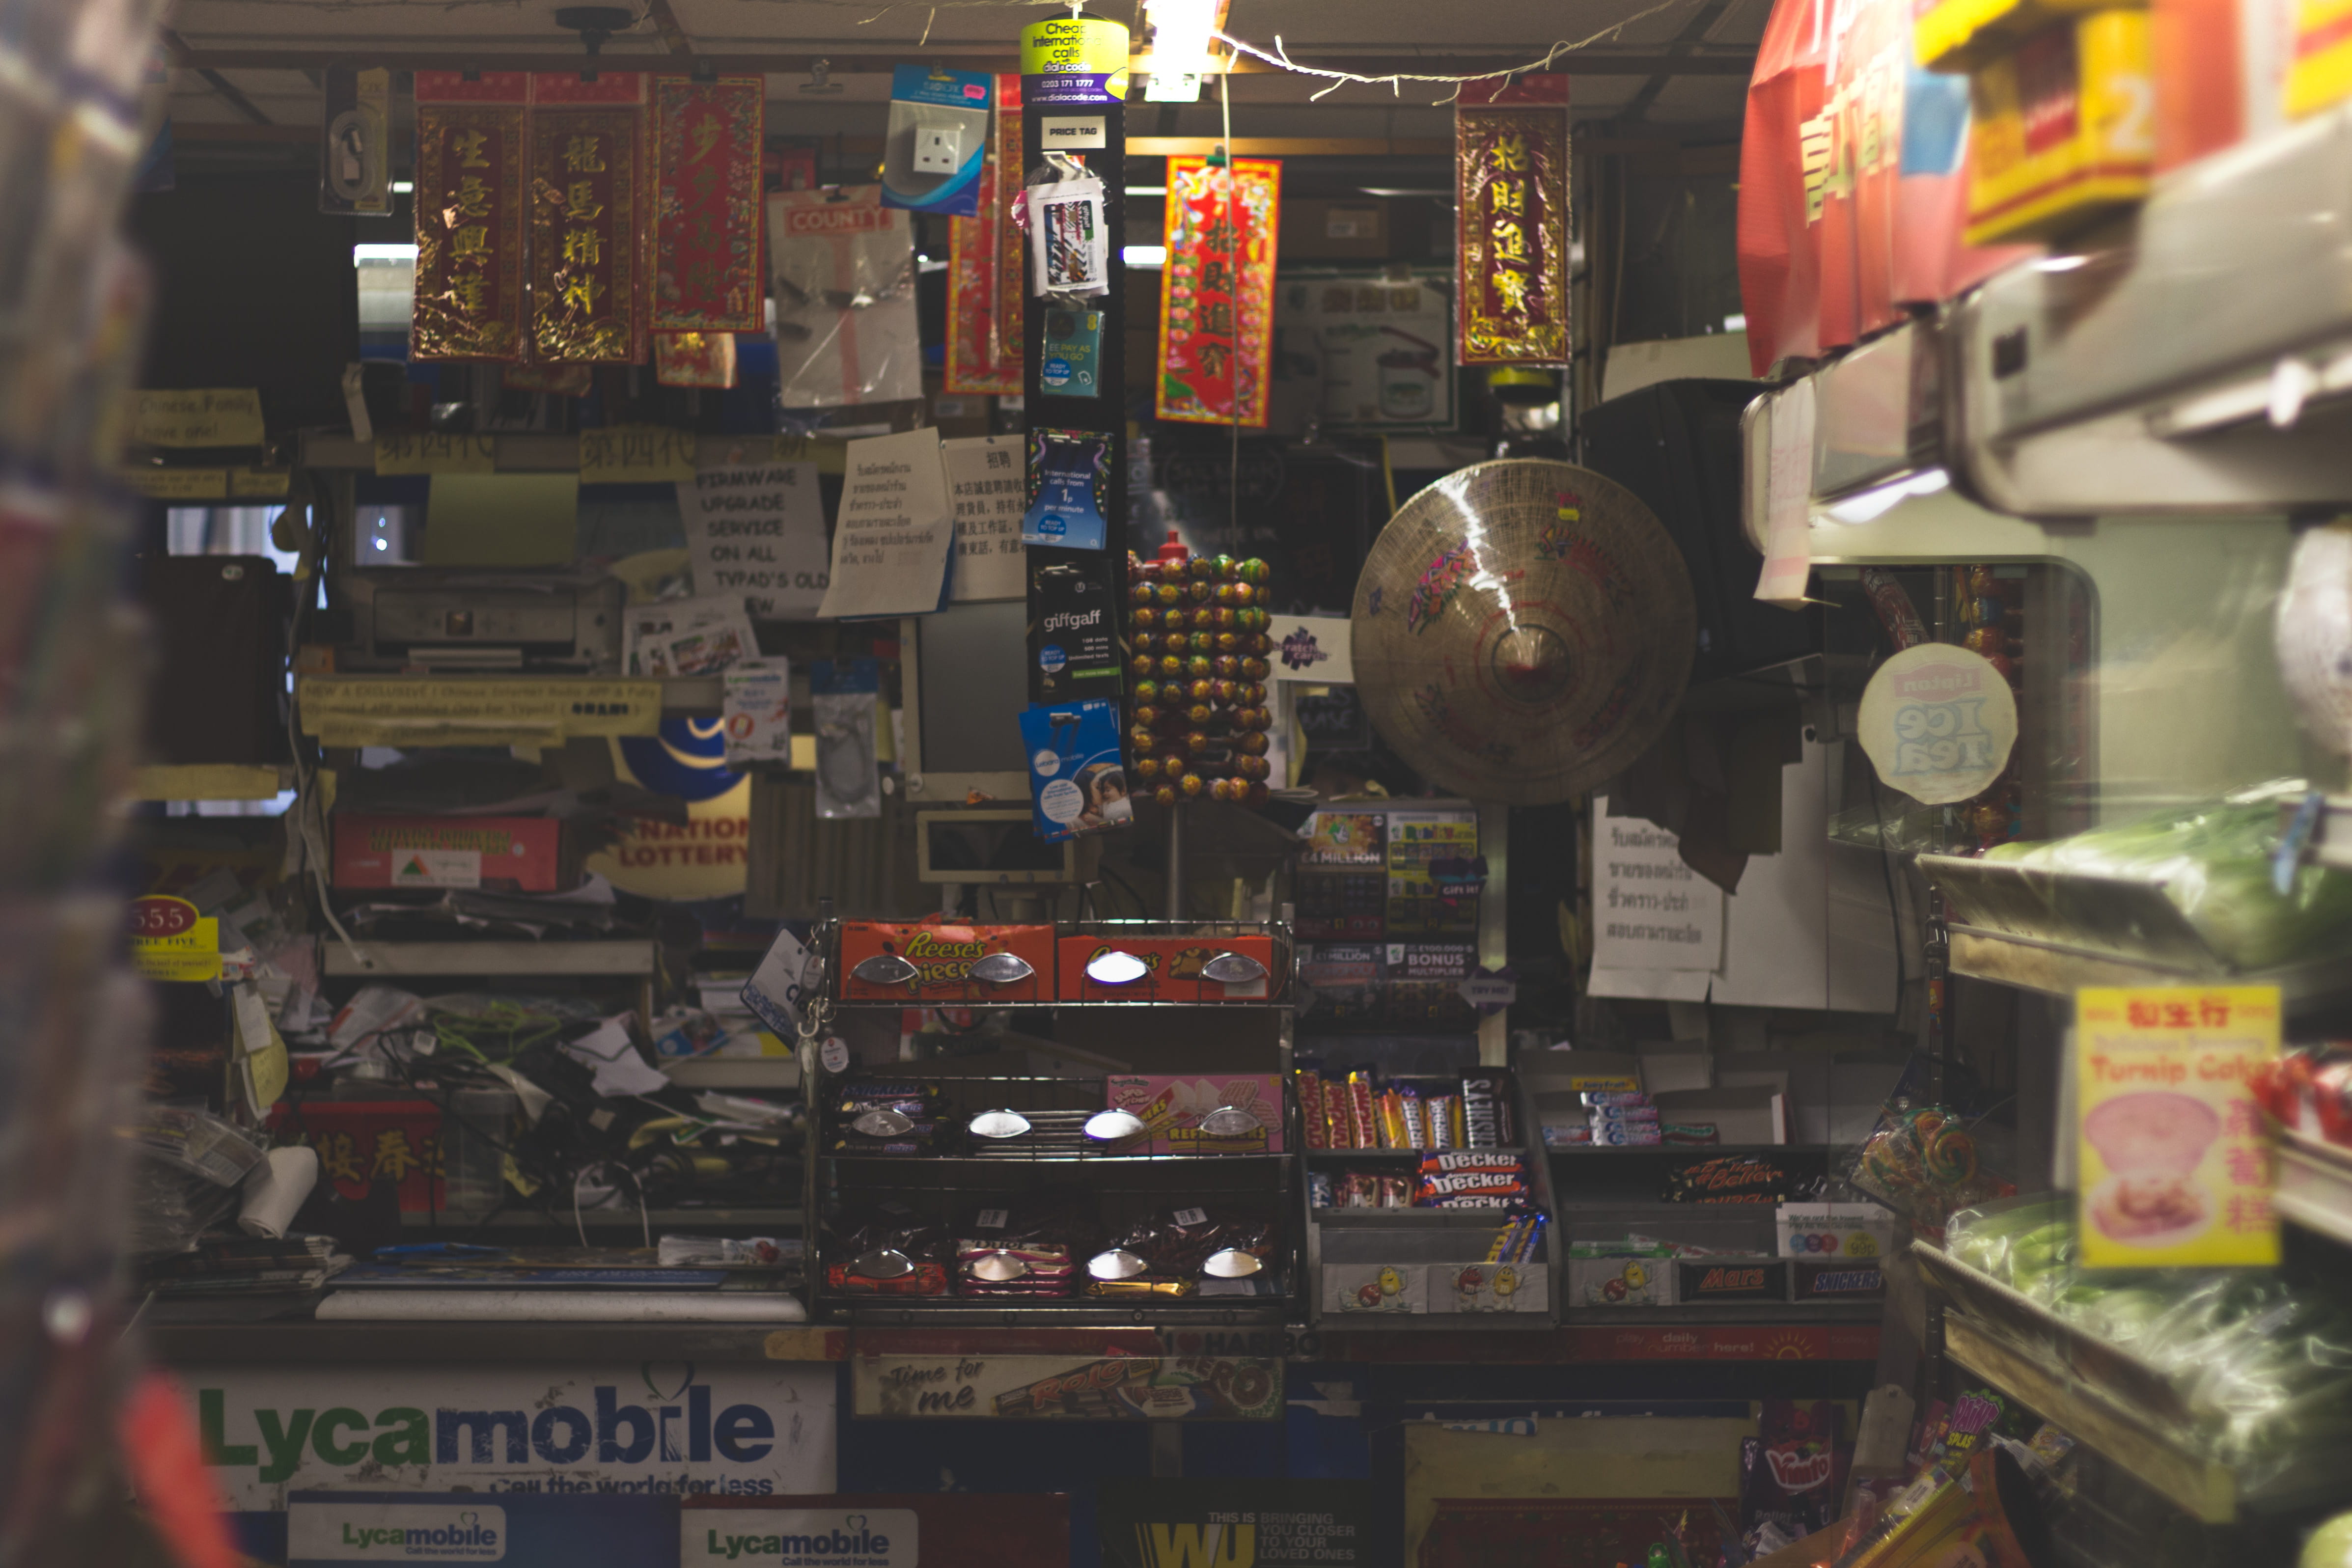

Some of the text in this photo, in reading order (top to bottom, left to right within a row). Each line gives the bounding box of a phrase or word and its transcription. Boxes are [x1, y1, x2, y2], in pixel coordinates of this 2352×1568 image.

[1033, 36, 1102, 47] internationa
[1053, 48, 1080, 58] calls
[793, 203, 885, 230] COUNTY
[1045, 469, 1091, 479] International
[701, 492, 784, 512] UPGRADE
[708, 519, 783, 537] SERVICE
[711, 545, 776, 563] ON ALL
[1044, 609, 1102, 632] giffgaff
[1321, 852, 1380, 864] MILLION
[905, 932, 988, 958] Reese's
[1328, 949, 1370, 961] MILLION
[1408, 954, 1465, 966] BONUS
[1471, 986, 1508, 994] TRY ME!
[2090, 1055, 2186, 1086] Turnip
[1438, 1154, 1517, 1171] Decker
[1436, 1174, 1515, 1194] Decker
[1851, 1241, 1876, 1256] 99p
[1700, 1267, 1764, 1287] Mars
[1815, 1271, 1882, 1292] SNICKERS
[1616, 1333, 1645, 1345] play
[1662, 1332, 1699, 1345] daily
[1647, 1342, 1710, 1353] number
[1714, 1342, 1755, 1353] here!
[890, 1358, 984, 1384] Time for
[917, 1385, 976, 1412] me
[1949, 1396, 1999, 1434] PAINT
[198, 1383, 776, 1485] Lycamobile
[1946, 1432, 1976, 1449] SPLAS
[1766, 1450, 1829, 1486] Vimto
[548, 1476, 599, 1494] the
[602, 1476, 673, 1494] world
[674, 1476, 716, 1494] for
[720, 1476, 774, 1495] less
[1208, 1512, 1334, 1524] THIS IS BRINGING
[342, 1522, 498, 1549] Lycamobile
[1261, 1536, 1327, 1548] TO YOUR
[406, 1546, 497, 1556] Call the world for less
[708, 1529, 890, 1560] Lycamobile
[1135, 1523, 1356, 1568] WU YOU CLOSER
[782, 1557, 889, 1567] Call the world for less
[1261, 1547, 1356, 1560] LOVED ONES
